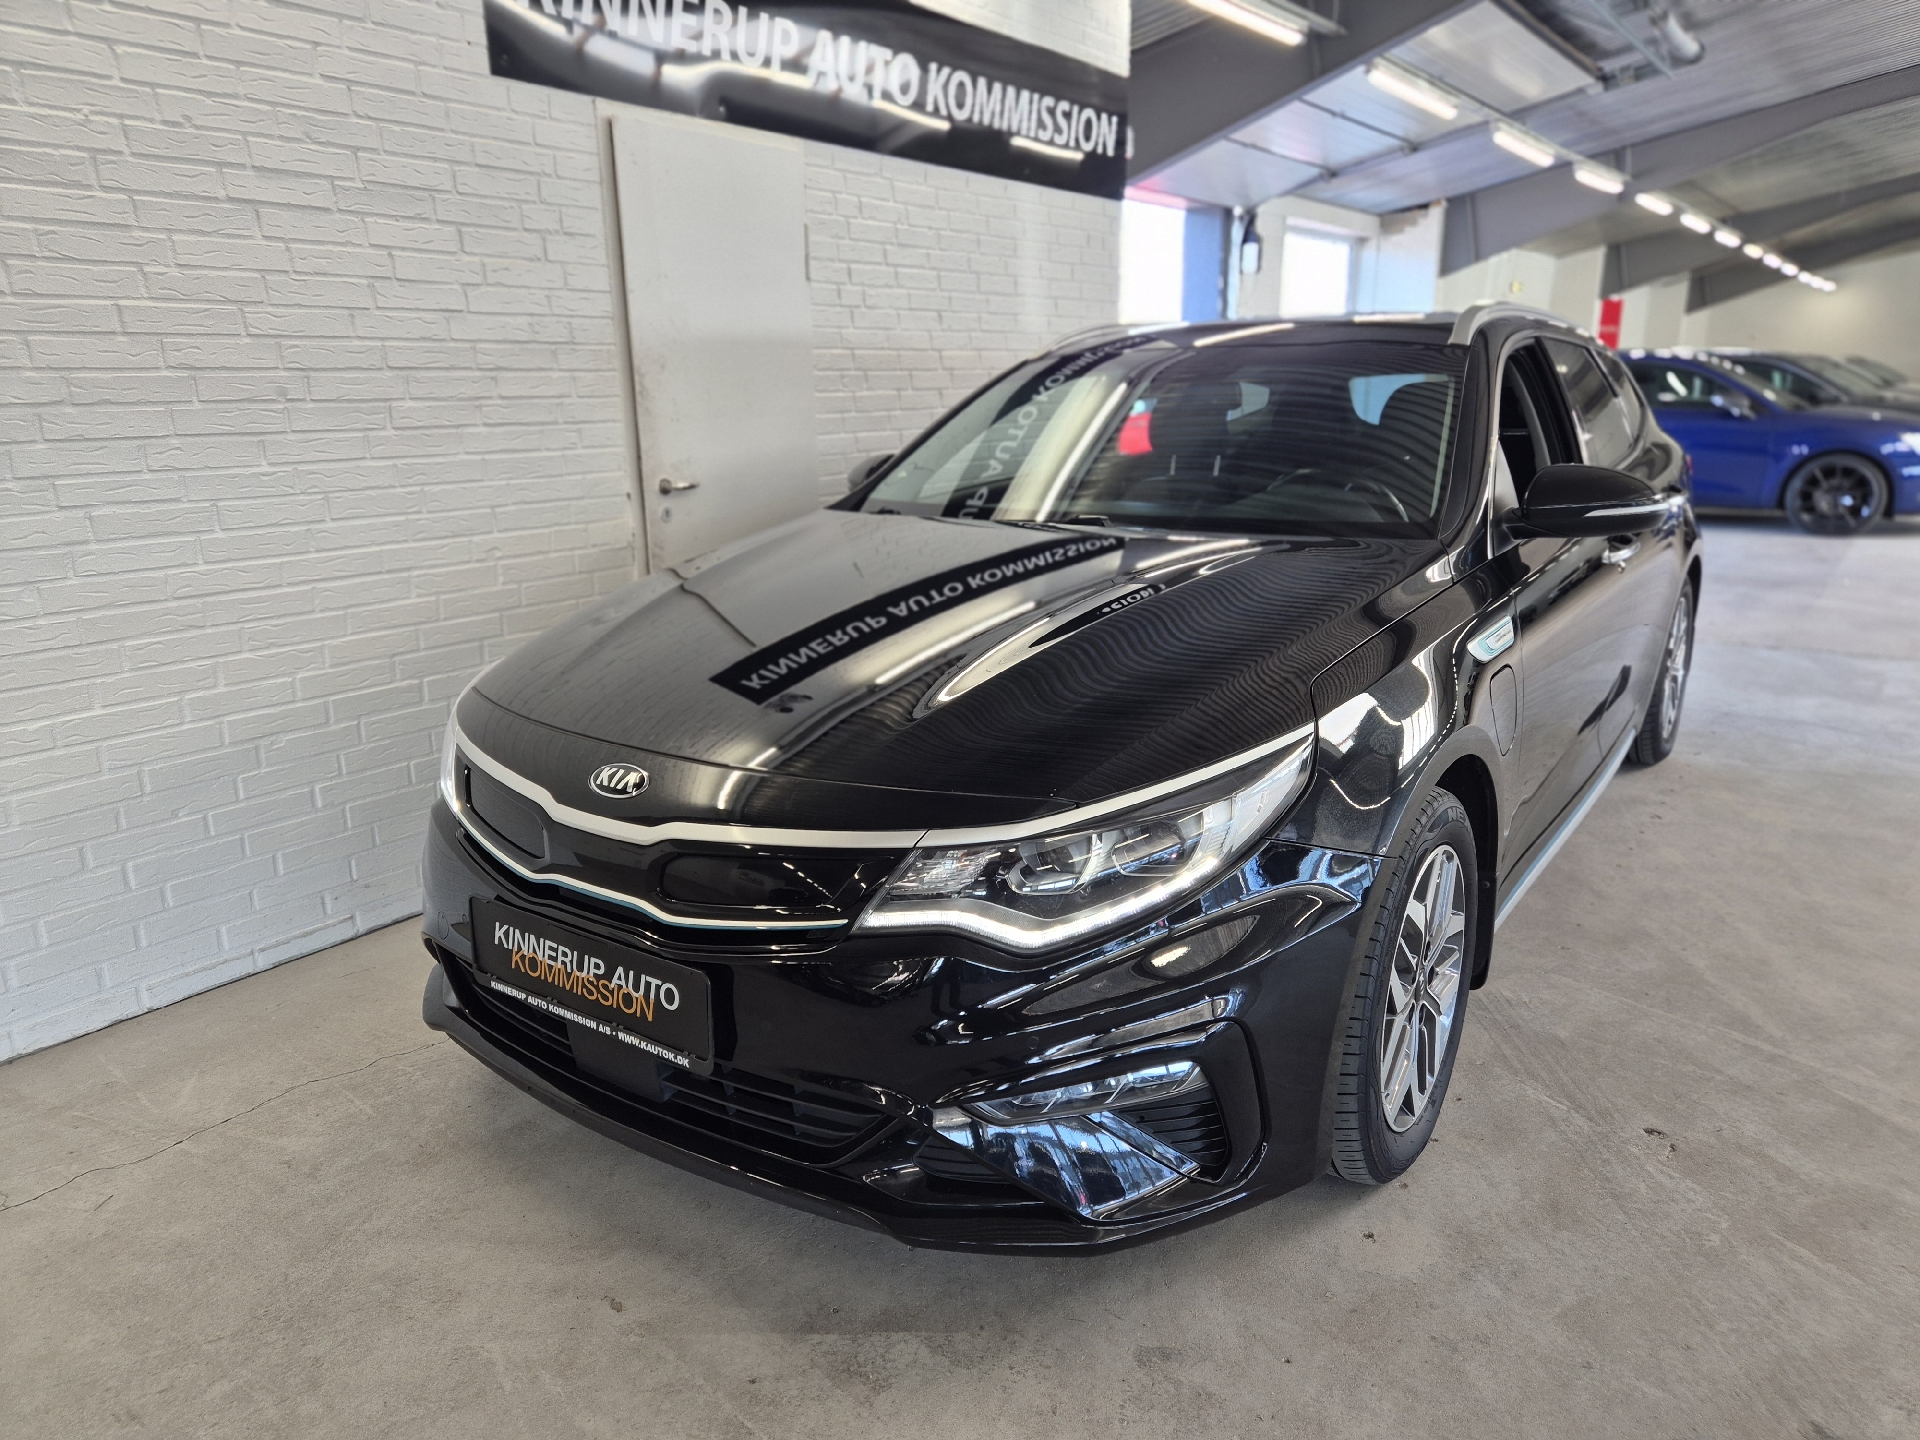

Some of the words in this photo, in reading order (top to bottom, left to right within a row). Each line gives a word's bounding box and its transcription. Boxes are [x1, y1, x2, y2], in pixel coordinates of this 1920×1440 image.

[520, 0, 800, 73] NNERUP
[807, 28, 921, 107] AUTO
[925, 61, 1119, 157] KOMMISSION
[595, 766, 638, 793] KIA
[494, 921, 606, 979] KINNERUP
[610, 965, 680, 1011] AUTO
[511, 947, 655, 1022] KOMMISSION
[490, 980, 527, 1001] KINNERUP
[527, 995, 548, 1010] AUTO
[548, 1003, 597, 1030] KOMMISSION
[598, 1023, 611, 1036] A/S
[617, 1031, 690, 1068] WWW.KAUTOK.DK
